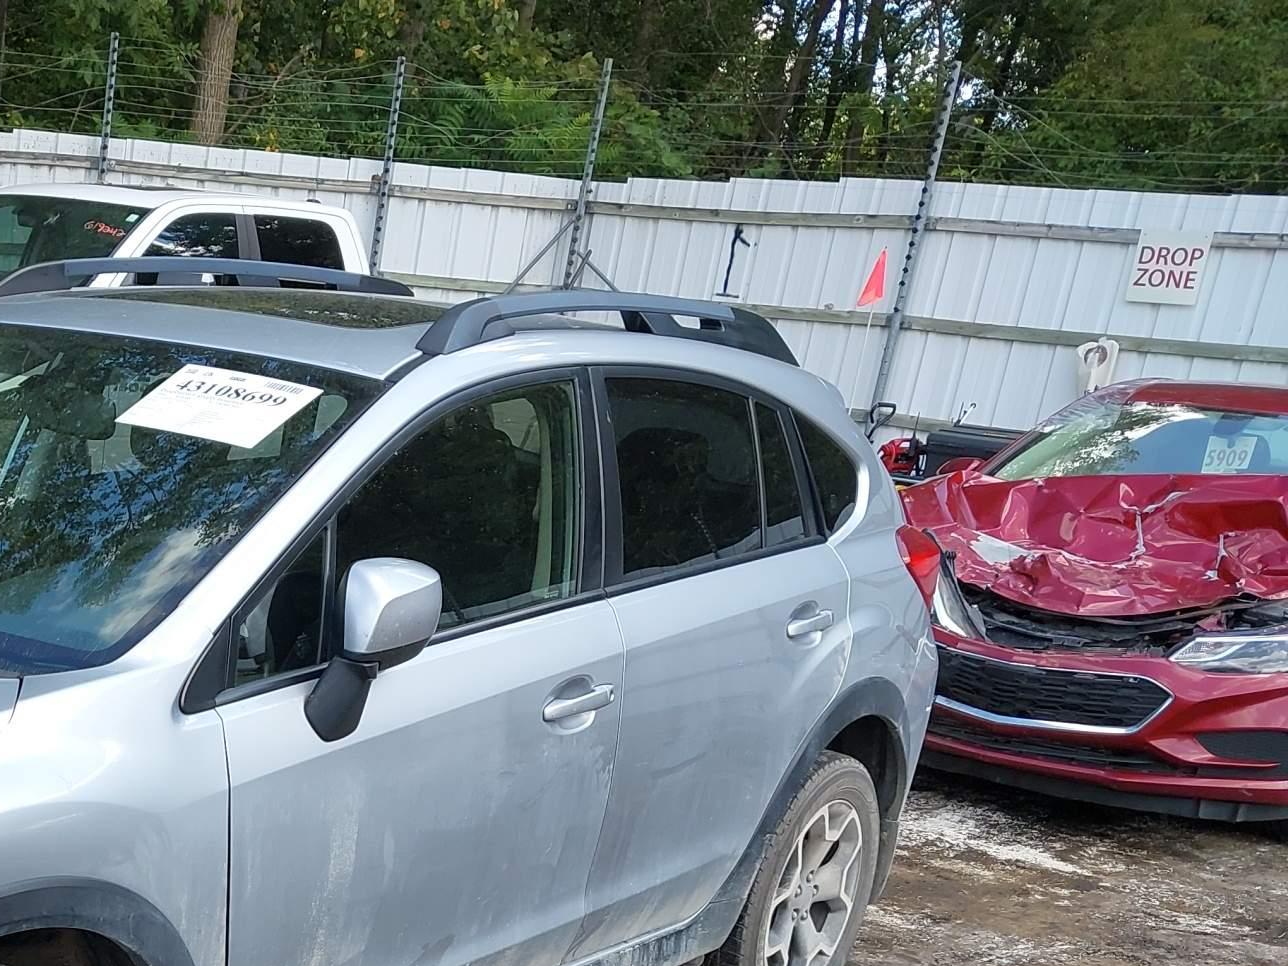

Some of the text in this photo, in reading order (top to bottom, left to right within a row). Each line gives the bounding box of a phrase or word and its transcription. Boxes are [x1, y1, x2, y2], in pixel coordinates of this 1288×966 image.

[1138, 246, 1205, 267] DROP
[1133, 268, 1198, 290] ZONE
[176, 379, 288, 407] 43108699
[1205, 449, 1249, 467] 5909
